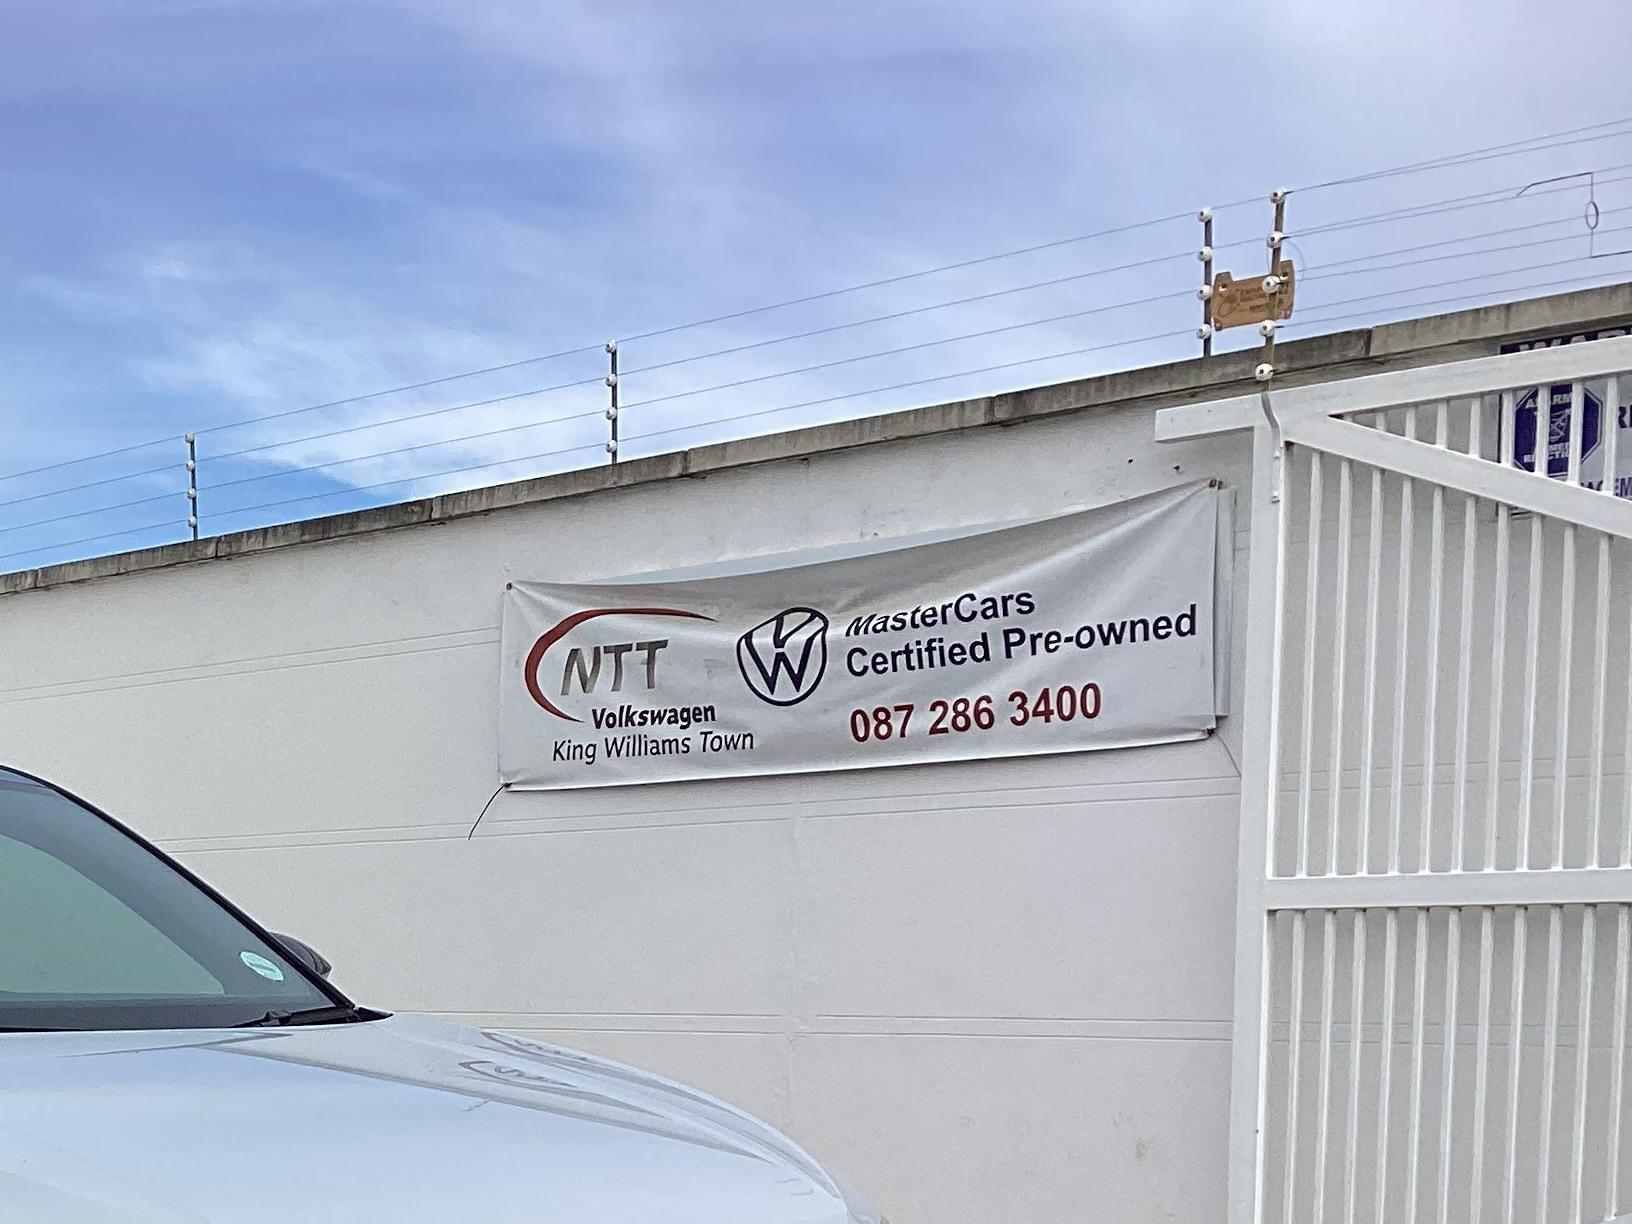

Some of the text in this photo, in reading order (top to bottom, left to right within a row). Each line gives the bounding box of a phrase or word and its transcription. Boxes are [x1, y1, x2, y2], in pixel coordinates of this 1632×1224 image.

[845, 591, 1036, 637] MasterCars
[846, 603, 1198, 677] Certified Pre-owned
[560, 639, 669, 696] NTT
[591, 705, 717, 730] Volkswagen
[850, 682, 1102, 743] 087 286 3400
[552, 730, 755, 765] King Williams Town
